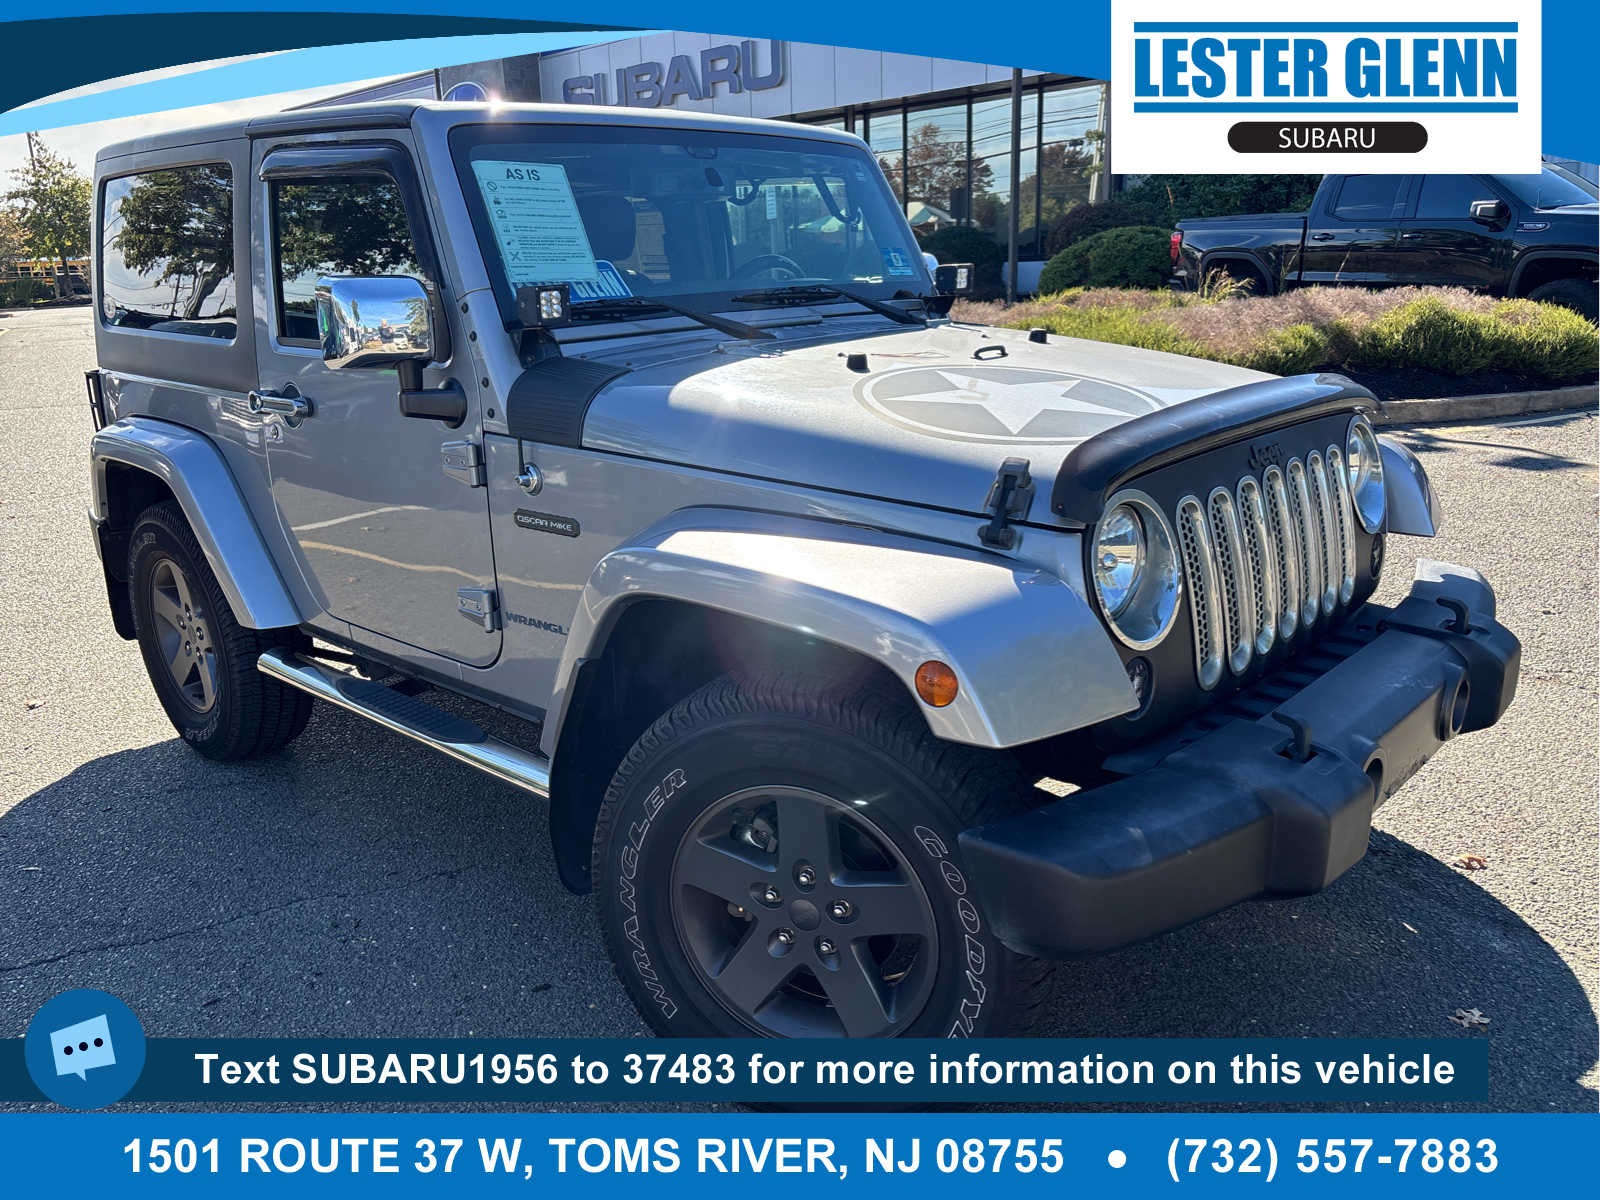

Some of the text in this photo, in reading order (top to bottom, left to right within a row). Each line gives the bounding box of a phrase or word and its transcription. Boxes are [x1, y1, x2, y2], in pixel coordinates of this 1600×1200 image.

[562, 38, 787, 108] SUBARU
[506, 168, 541, 181] AS IS
[516, 514, 574, 532] OSCAR MIKE
[505, 611, 570, 636] WRANGL
[619, 767, 688, 1020] WRANGLER
